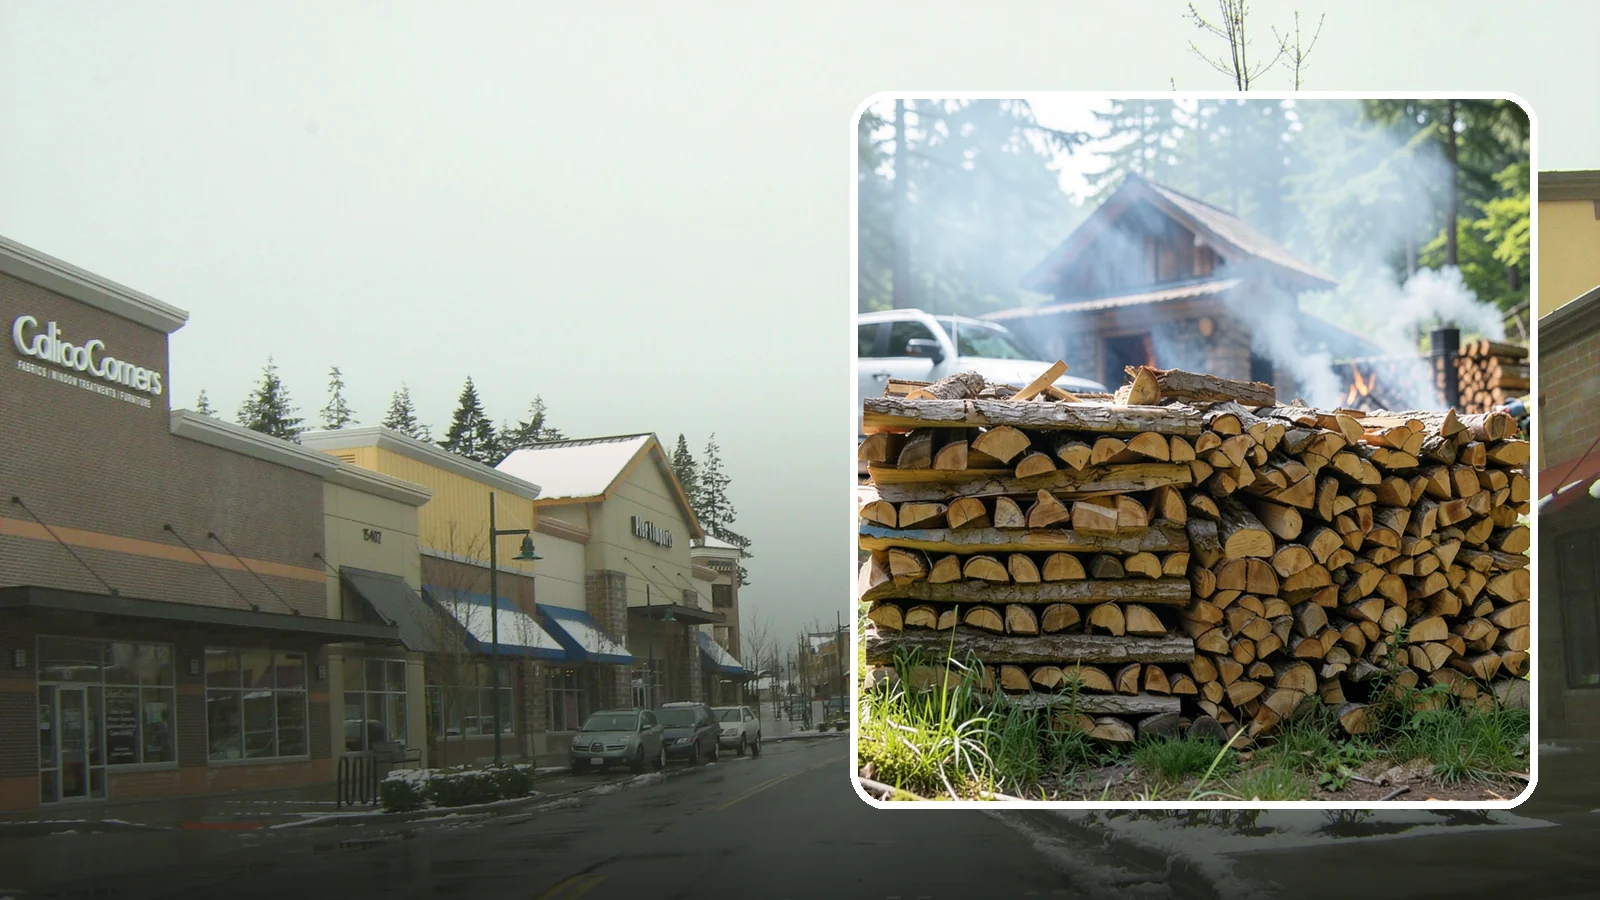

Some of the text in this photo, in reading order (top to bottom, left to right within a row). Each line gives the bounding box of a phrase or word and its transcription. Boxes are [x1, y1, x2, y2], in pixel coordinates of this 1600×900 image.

[17, 359, 47, 377] FABRICS
[51, 370, 78, 386] WINDOW
[79, 378, 117, 398] TREATMENTS
